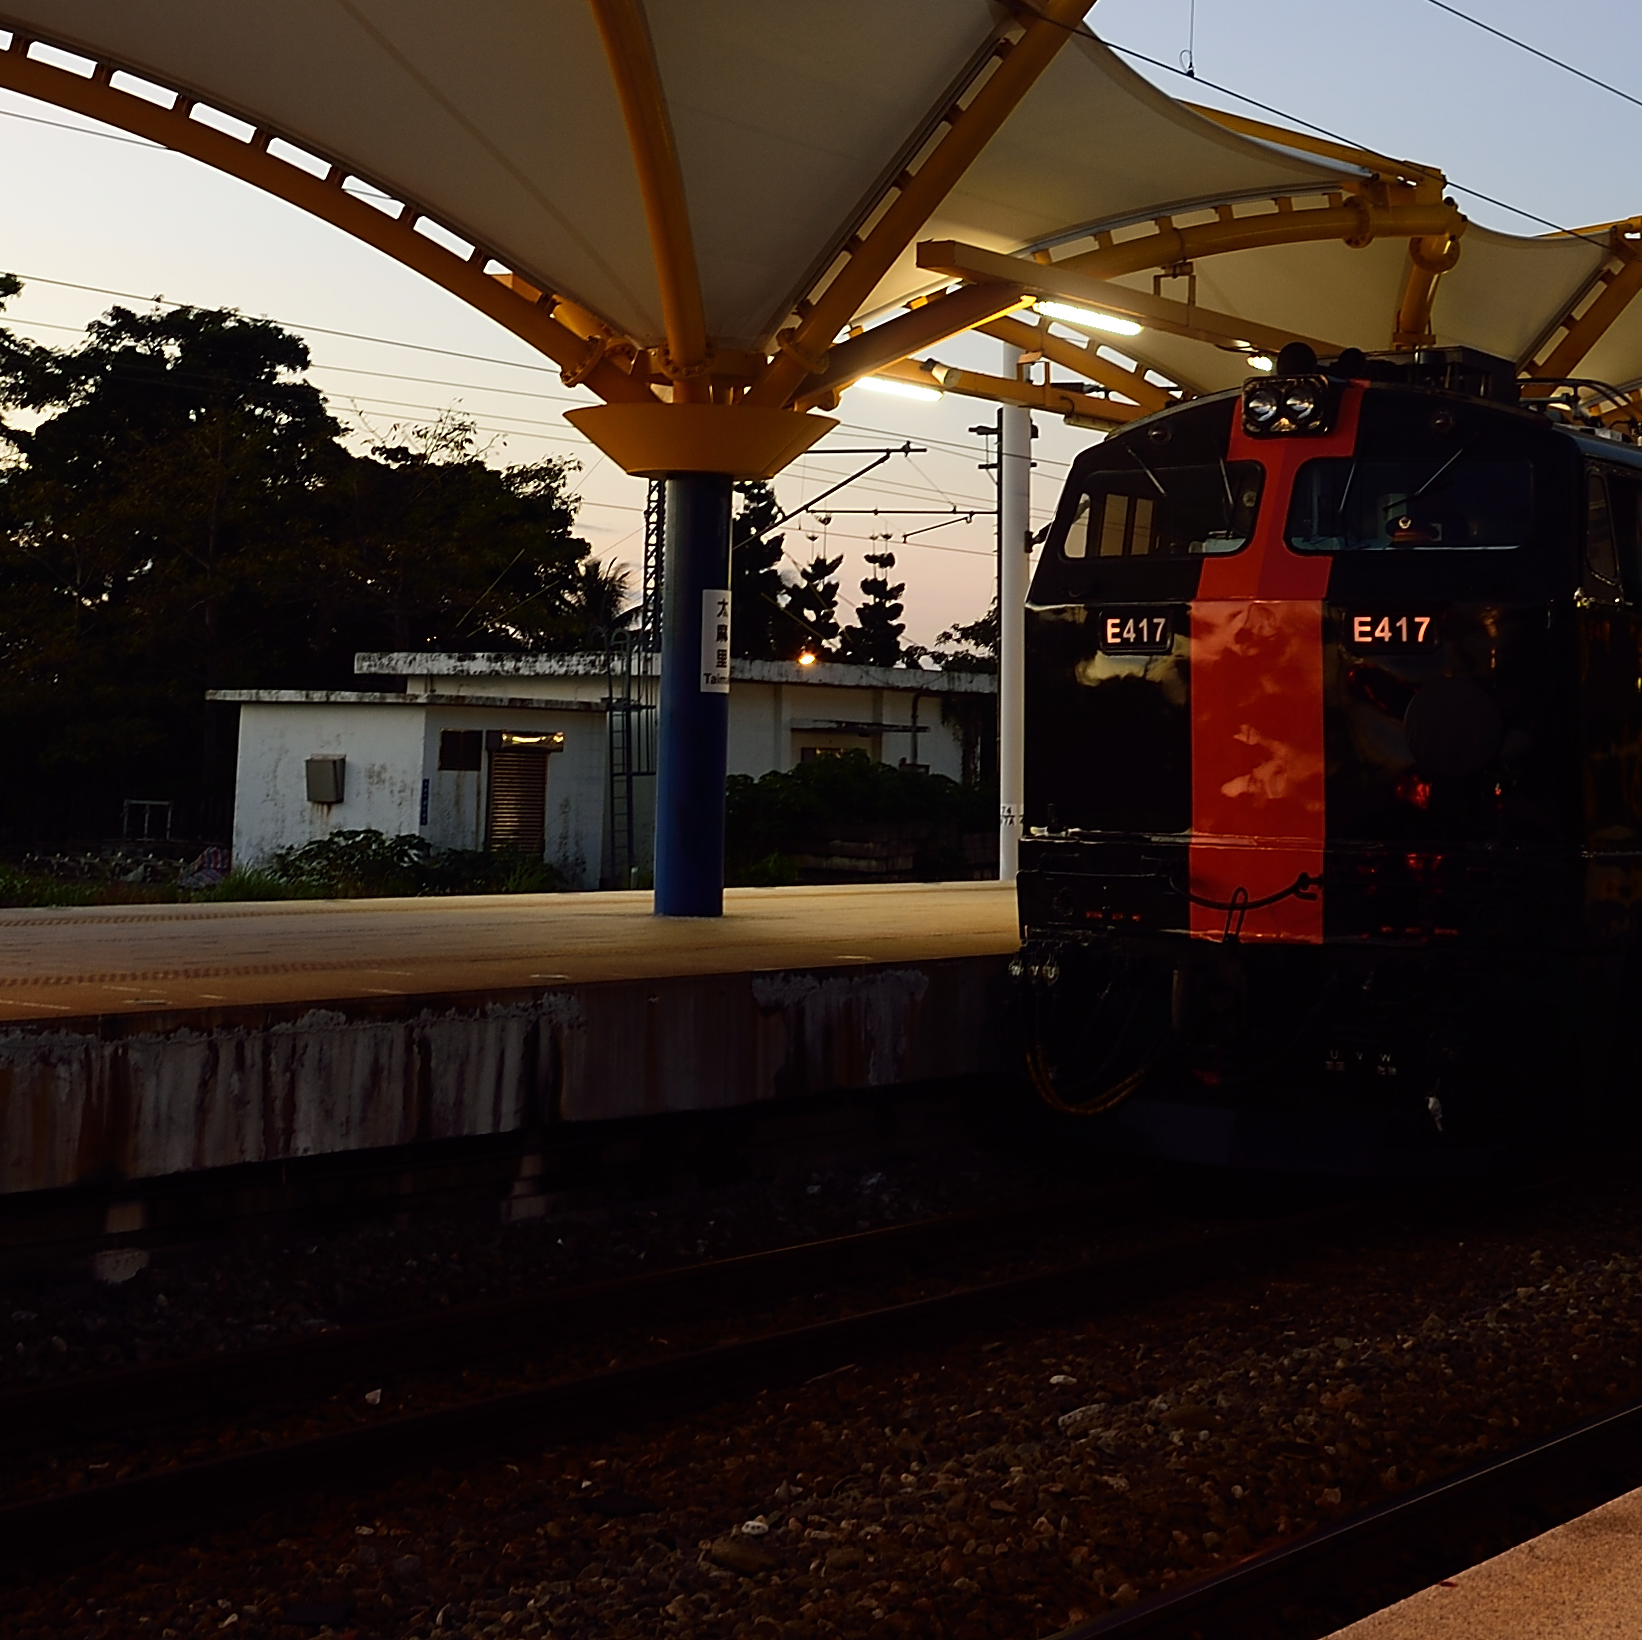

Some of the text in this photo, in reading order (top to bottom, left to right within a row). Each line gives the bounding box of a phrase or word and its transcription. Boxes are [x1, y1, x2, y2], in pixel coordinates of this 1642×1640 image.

[1106, 618, 1166, 643] E417
[1353, 616, 1432, 643] E417
[1329, 1050, 1339, 1060] U
[1379, 1053, 1392, 1063] W
